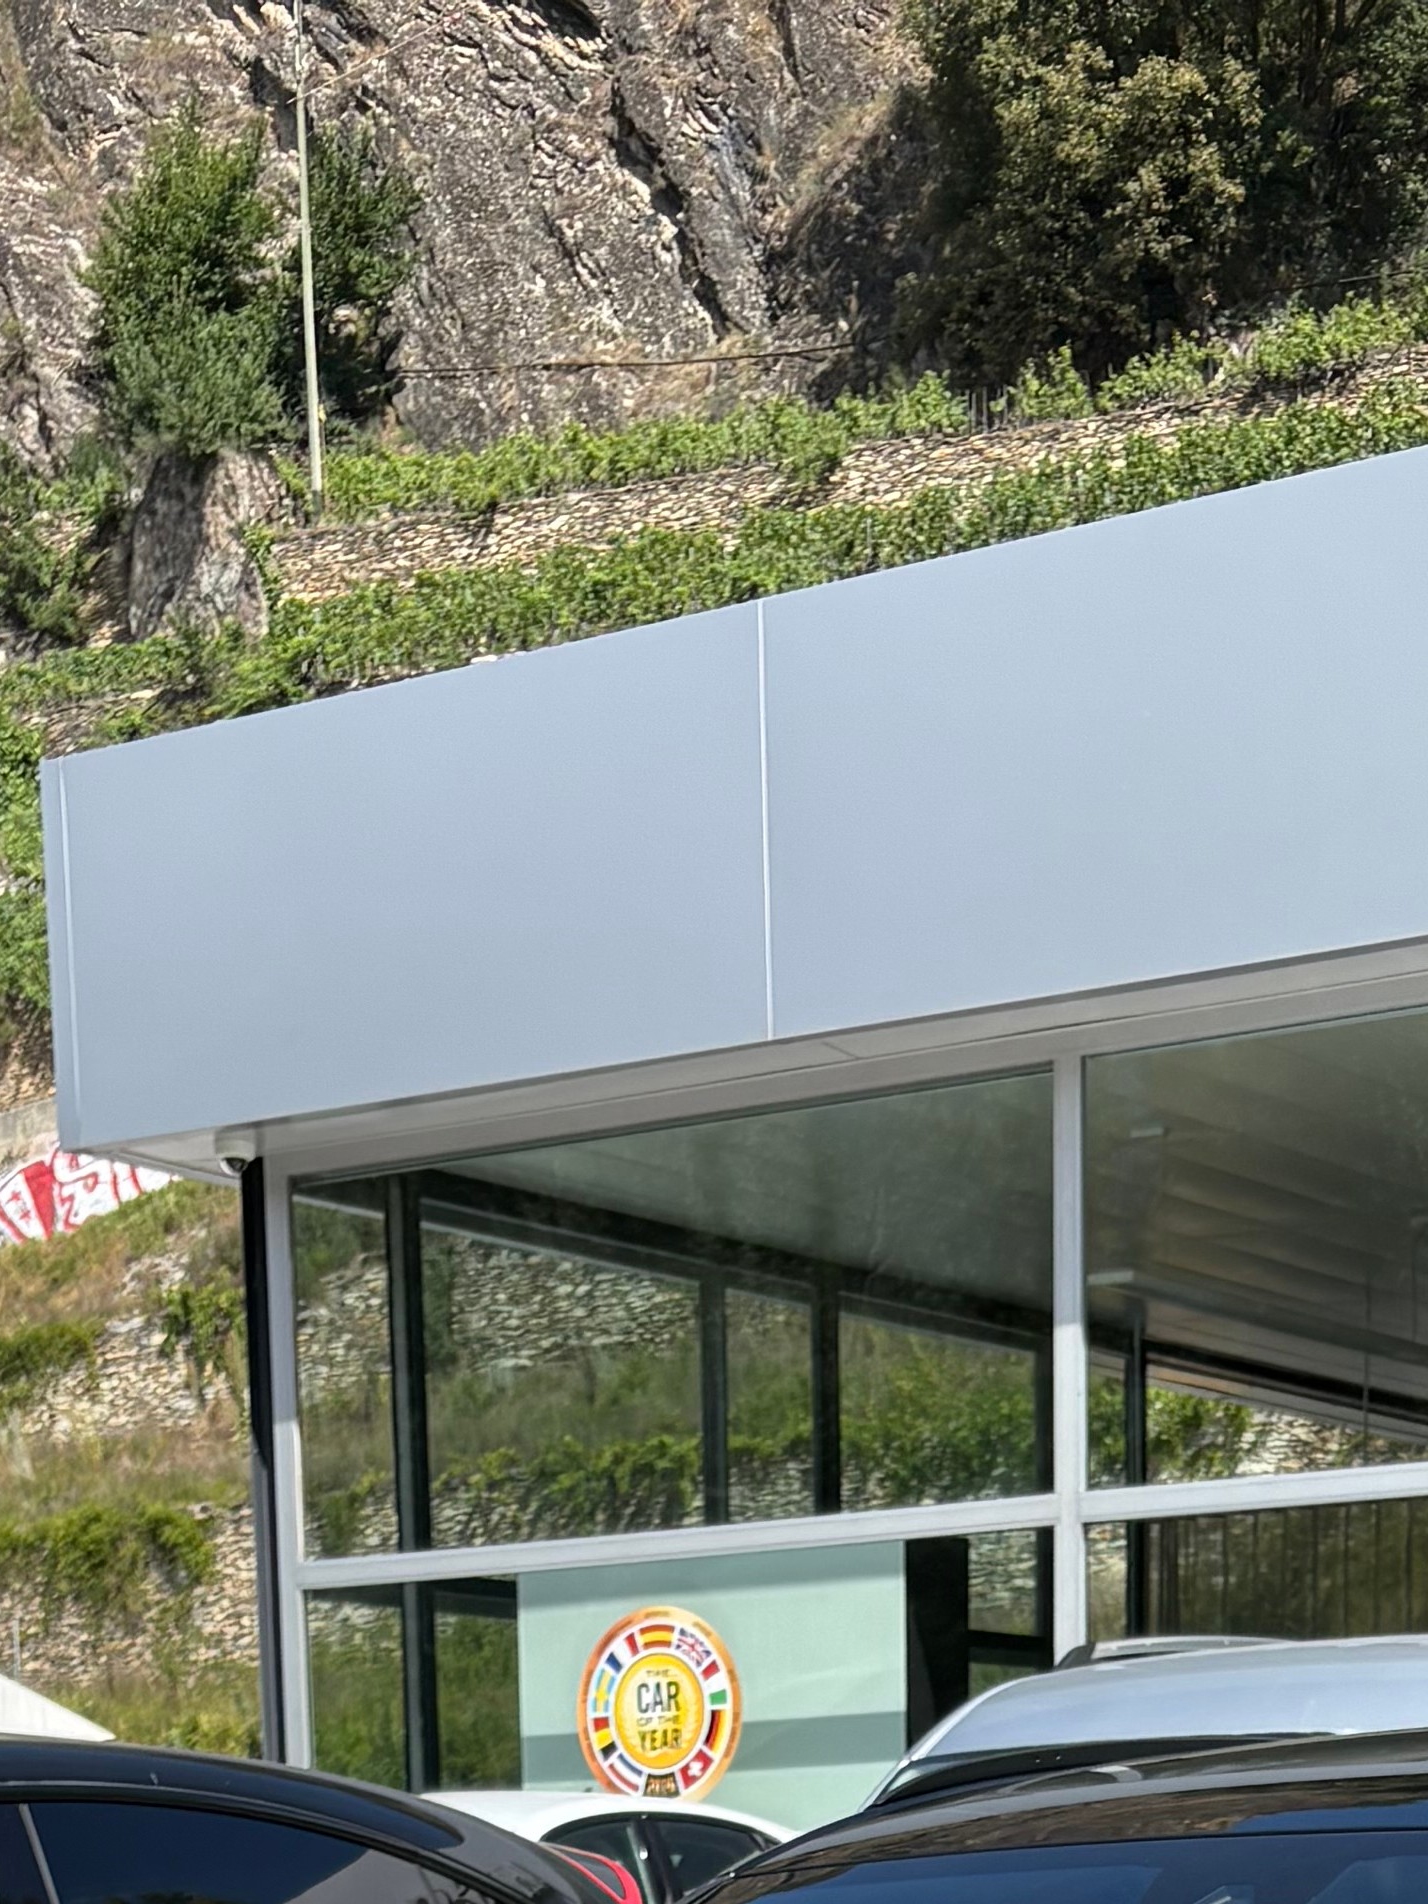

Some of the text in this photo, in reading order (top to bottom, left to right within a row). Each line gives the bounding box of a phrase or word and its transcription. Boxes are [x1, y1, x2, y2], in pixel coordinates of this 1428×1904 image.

[637, 1681, 681, 1713] CAR
[637, 1714, 680, 1727] OF THE
[638, 1728, 683, 1752] YEAR
